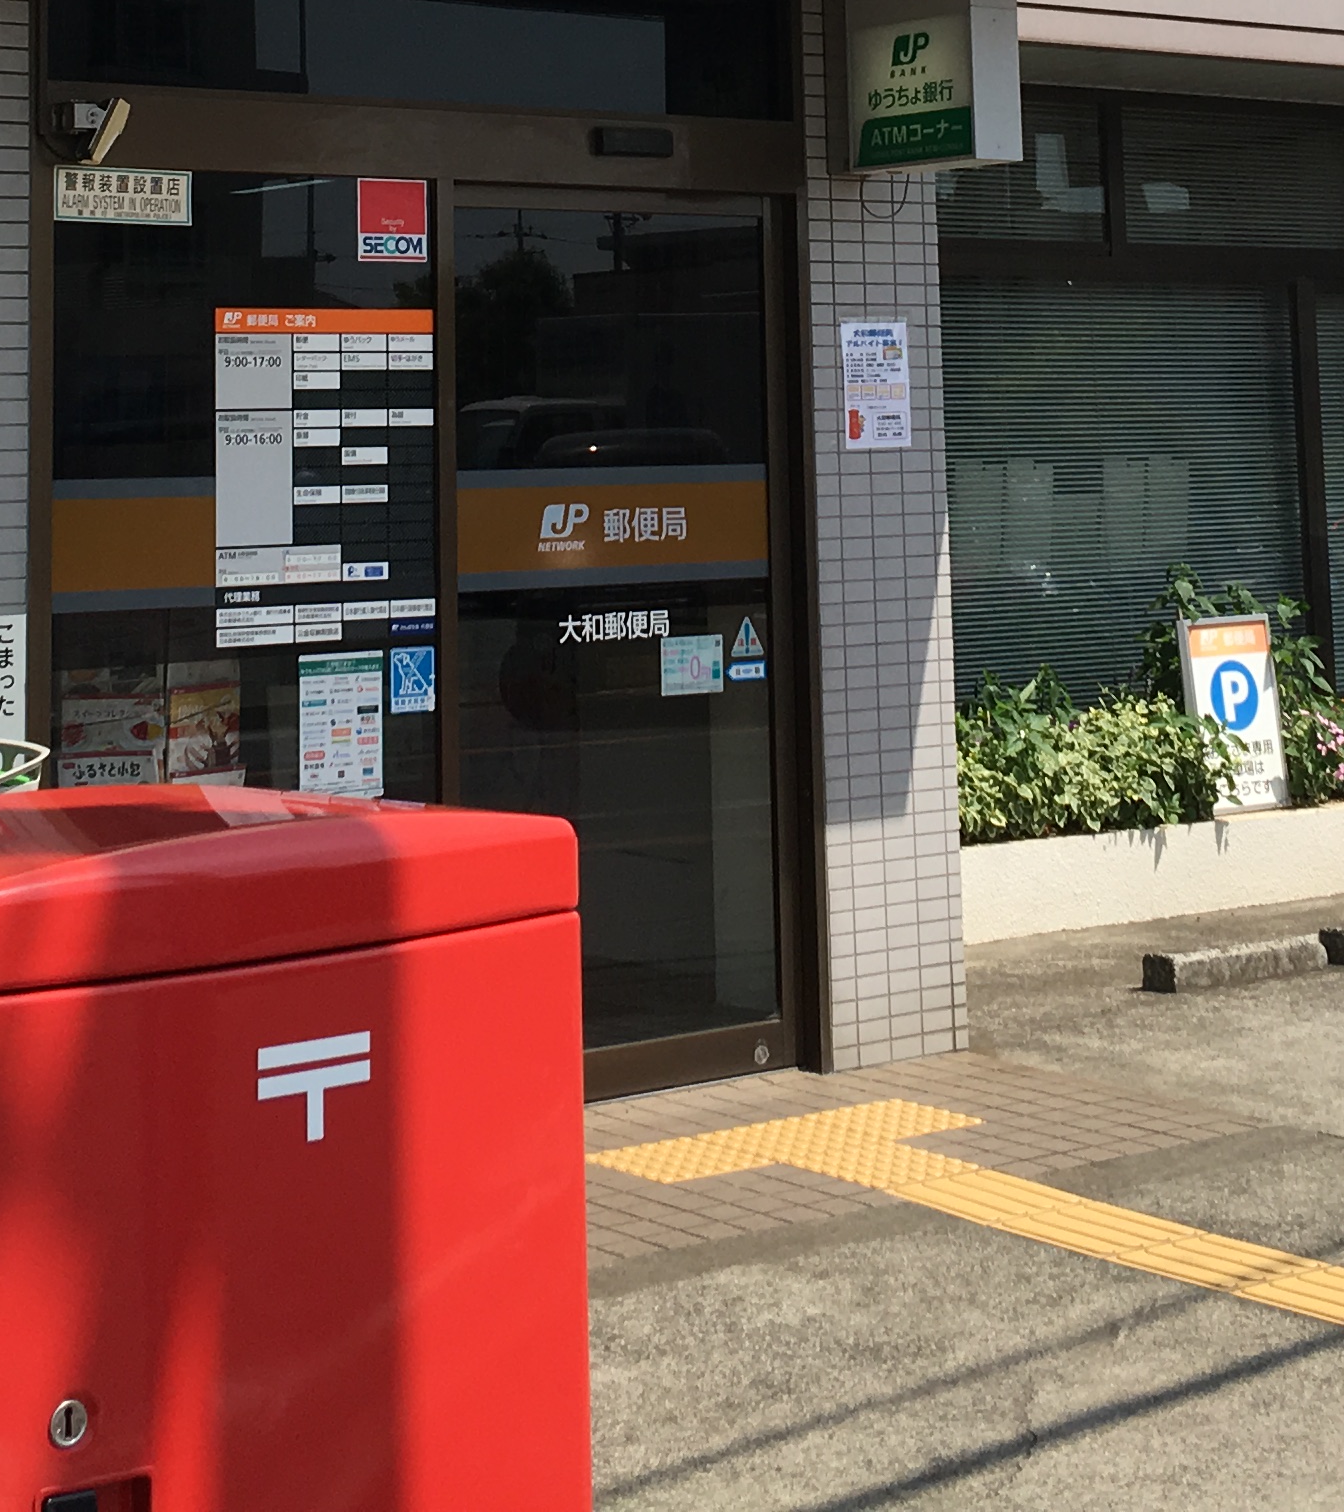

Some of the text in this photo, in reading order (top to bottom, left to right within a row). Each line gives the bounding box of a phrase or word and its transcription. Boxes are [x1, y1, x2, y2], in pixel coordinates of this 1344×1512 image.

[889, 65, 928, 79] BANK
[868, 79, 954, 111] ゆうちょ銀行
[870, 119, 963, 147] ATMコーナー
[64, 171, 181, 197] 警報装置設置店
[61, 193, 182, 214] ALARM SYSTEM IN OPERATION
[362, 236, 423, 255] SECOM
[246, 314, 279, 327] 郵便局
[284, 314, 317, 327] ご案内
[224, 355, 282, 368] 9:00-17:00
[225, 432, 283, 445] 9:00-16:00
[603, 506, 687, 543] 郵便局
[218, 552, 237, 560] ATM
[537, 540, 586, 552] NETWORK
[558, 609, 670, 644] 大和郵便局
[1219, 670, 1249, 723] P
[72, 760, 142, 780] ふるさと小包
